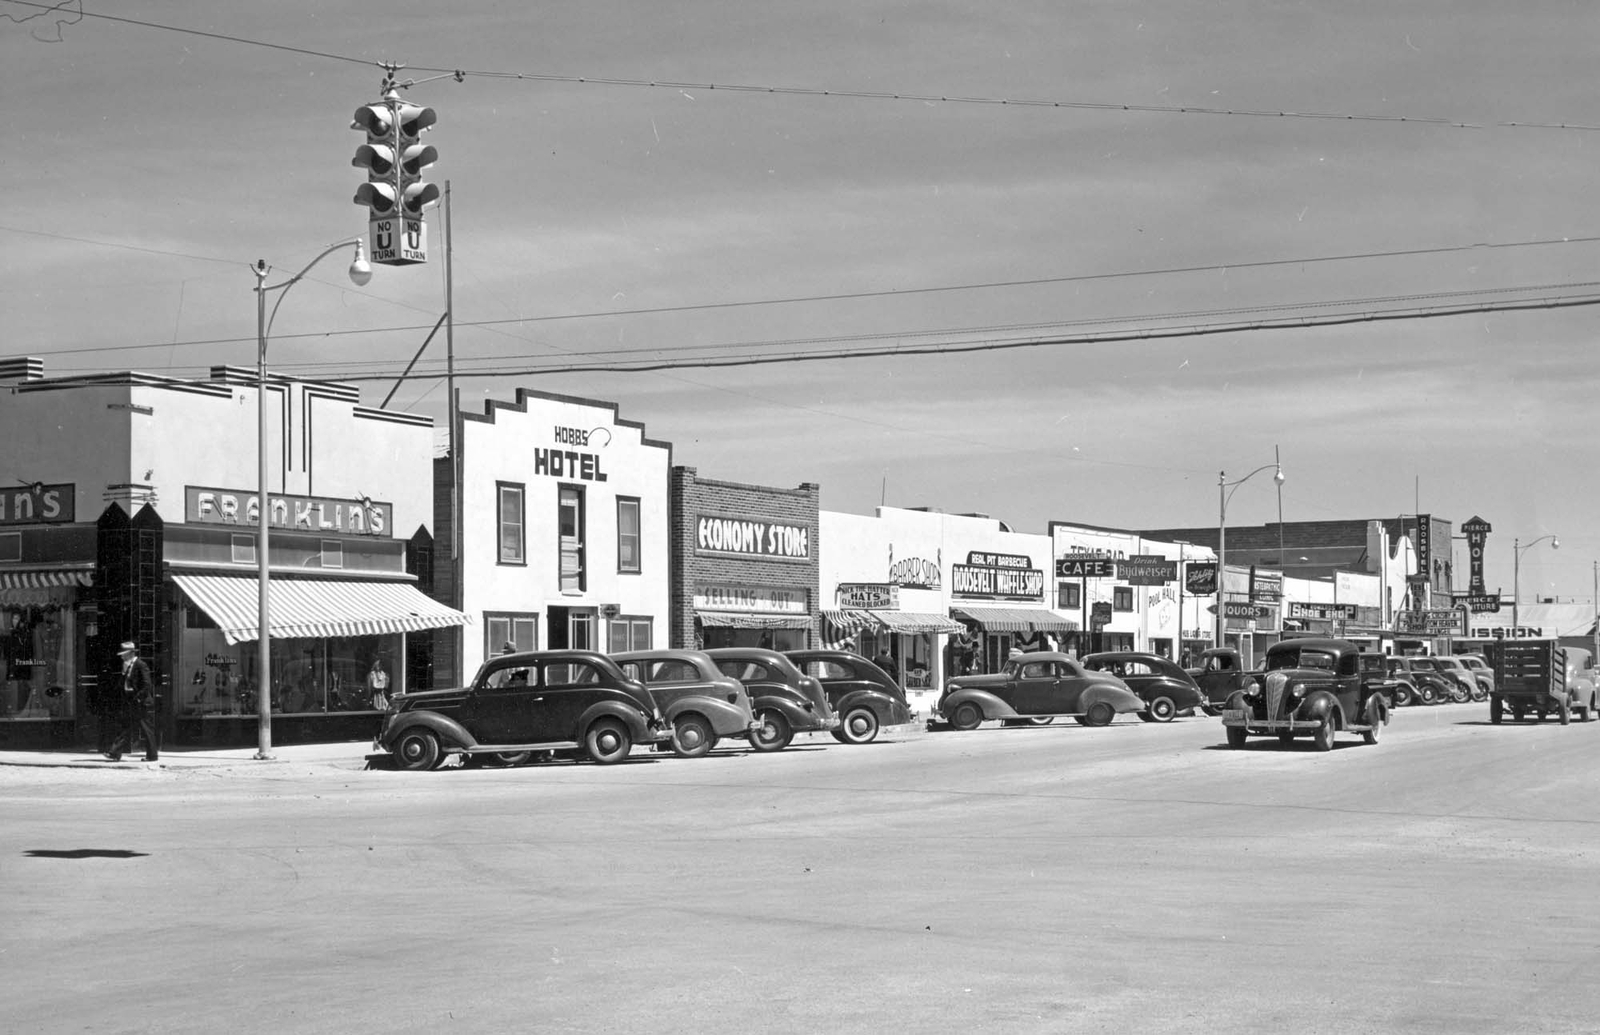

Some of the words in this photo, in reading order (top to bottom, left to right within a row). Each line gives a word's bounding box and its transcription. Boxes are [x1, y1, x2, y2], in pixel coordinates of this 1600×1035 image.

[378, 221, 391, 232] NO
[407, 221, 419, 232] NO
[377, 233, 391, 249] U
[408, 232, 420, 250] U
[372, 249, 395, 260] TURN
[404, 249, 426, 260] TURN
[554, 425, 588, 446] HOBBS
[534, 448, 607, 482] HOTEL
[699, 517, 764, 552] ECONOMY
[768, 524, 807, 556] STORE
[972, 553, 986, 564] REAL
[987, 555, 996, 565] PIT
[998, 556, 1028, 568] BARBECUE
[1062, 562, 1104, 574] CAFE
[1119, 564, 1172, 578] Budweiser
[953, 566, 995, 593] ROOSEVELT
[996, 569, 1024, 594] WAFFLE
[1025, 571, 1043, 595] SHOP
[842, 598, 865, 607] CLEANED
[867, 598, 890, 608] BLOCKED
[851, 592, 880, 601] HATS
[1224, 606, 1260, 616] IQUORS
[1292, 604, 1320, 618] SHOE
[1325, 606, 1354, 619] SHOP
[1472, 628, 1542, 638] ISSION
